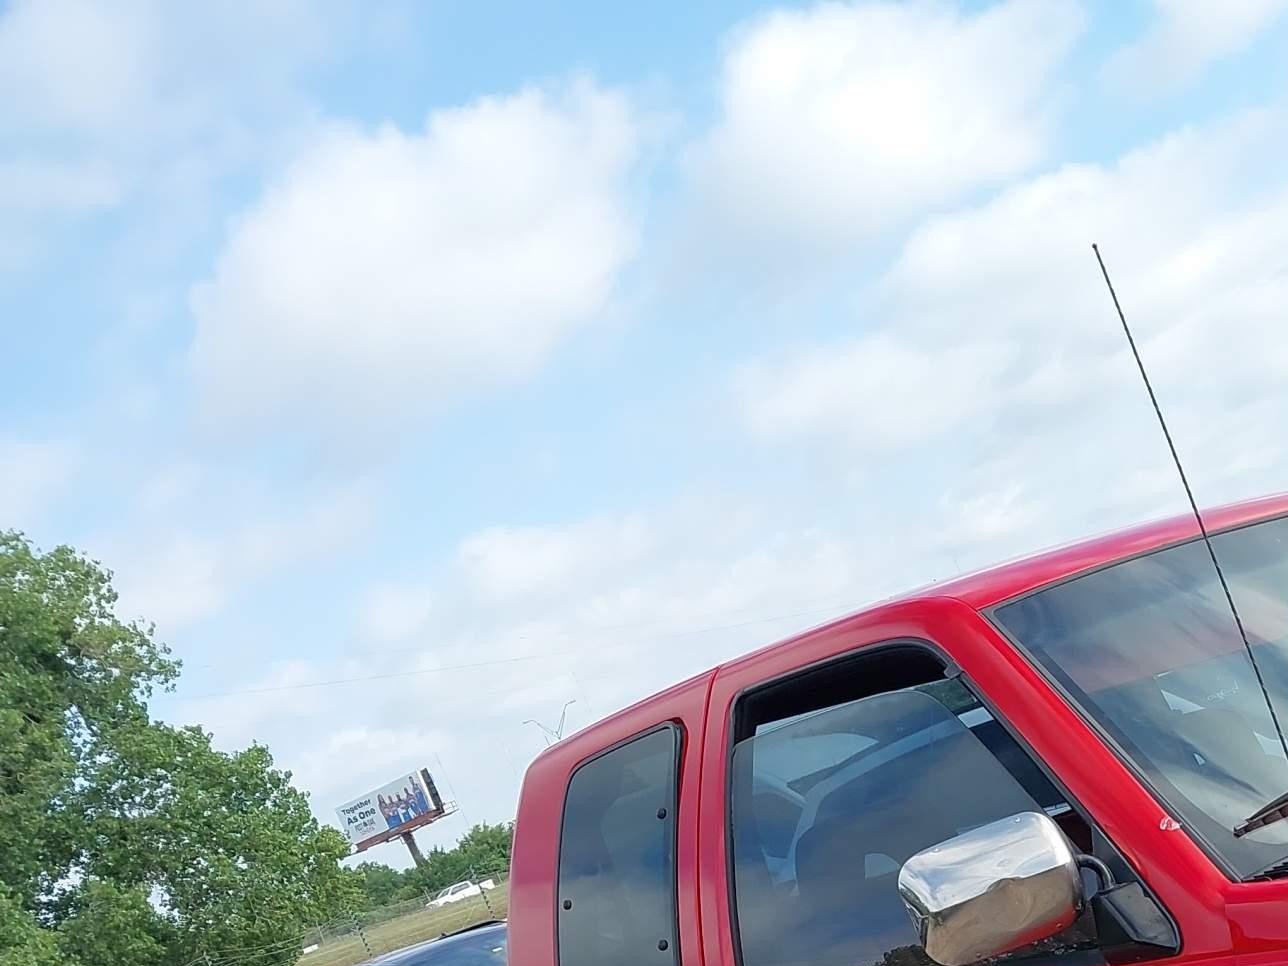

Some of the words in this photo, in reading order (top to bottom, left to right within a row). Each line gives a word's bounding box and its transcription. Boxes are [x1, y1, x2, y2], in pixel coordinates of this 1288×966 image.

[341, 800, 371, 815] Together
[347, 816, 358, 825] As
[359, 808, 376, 819] One
